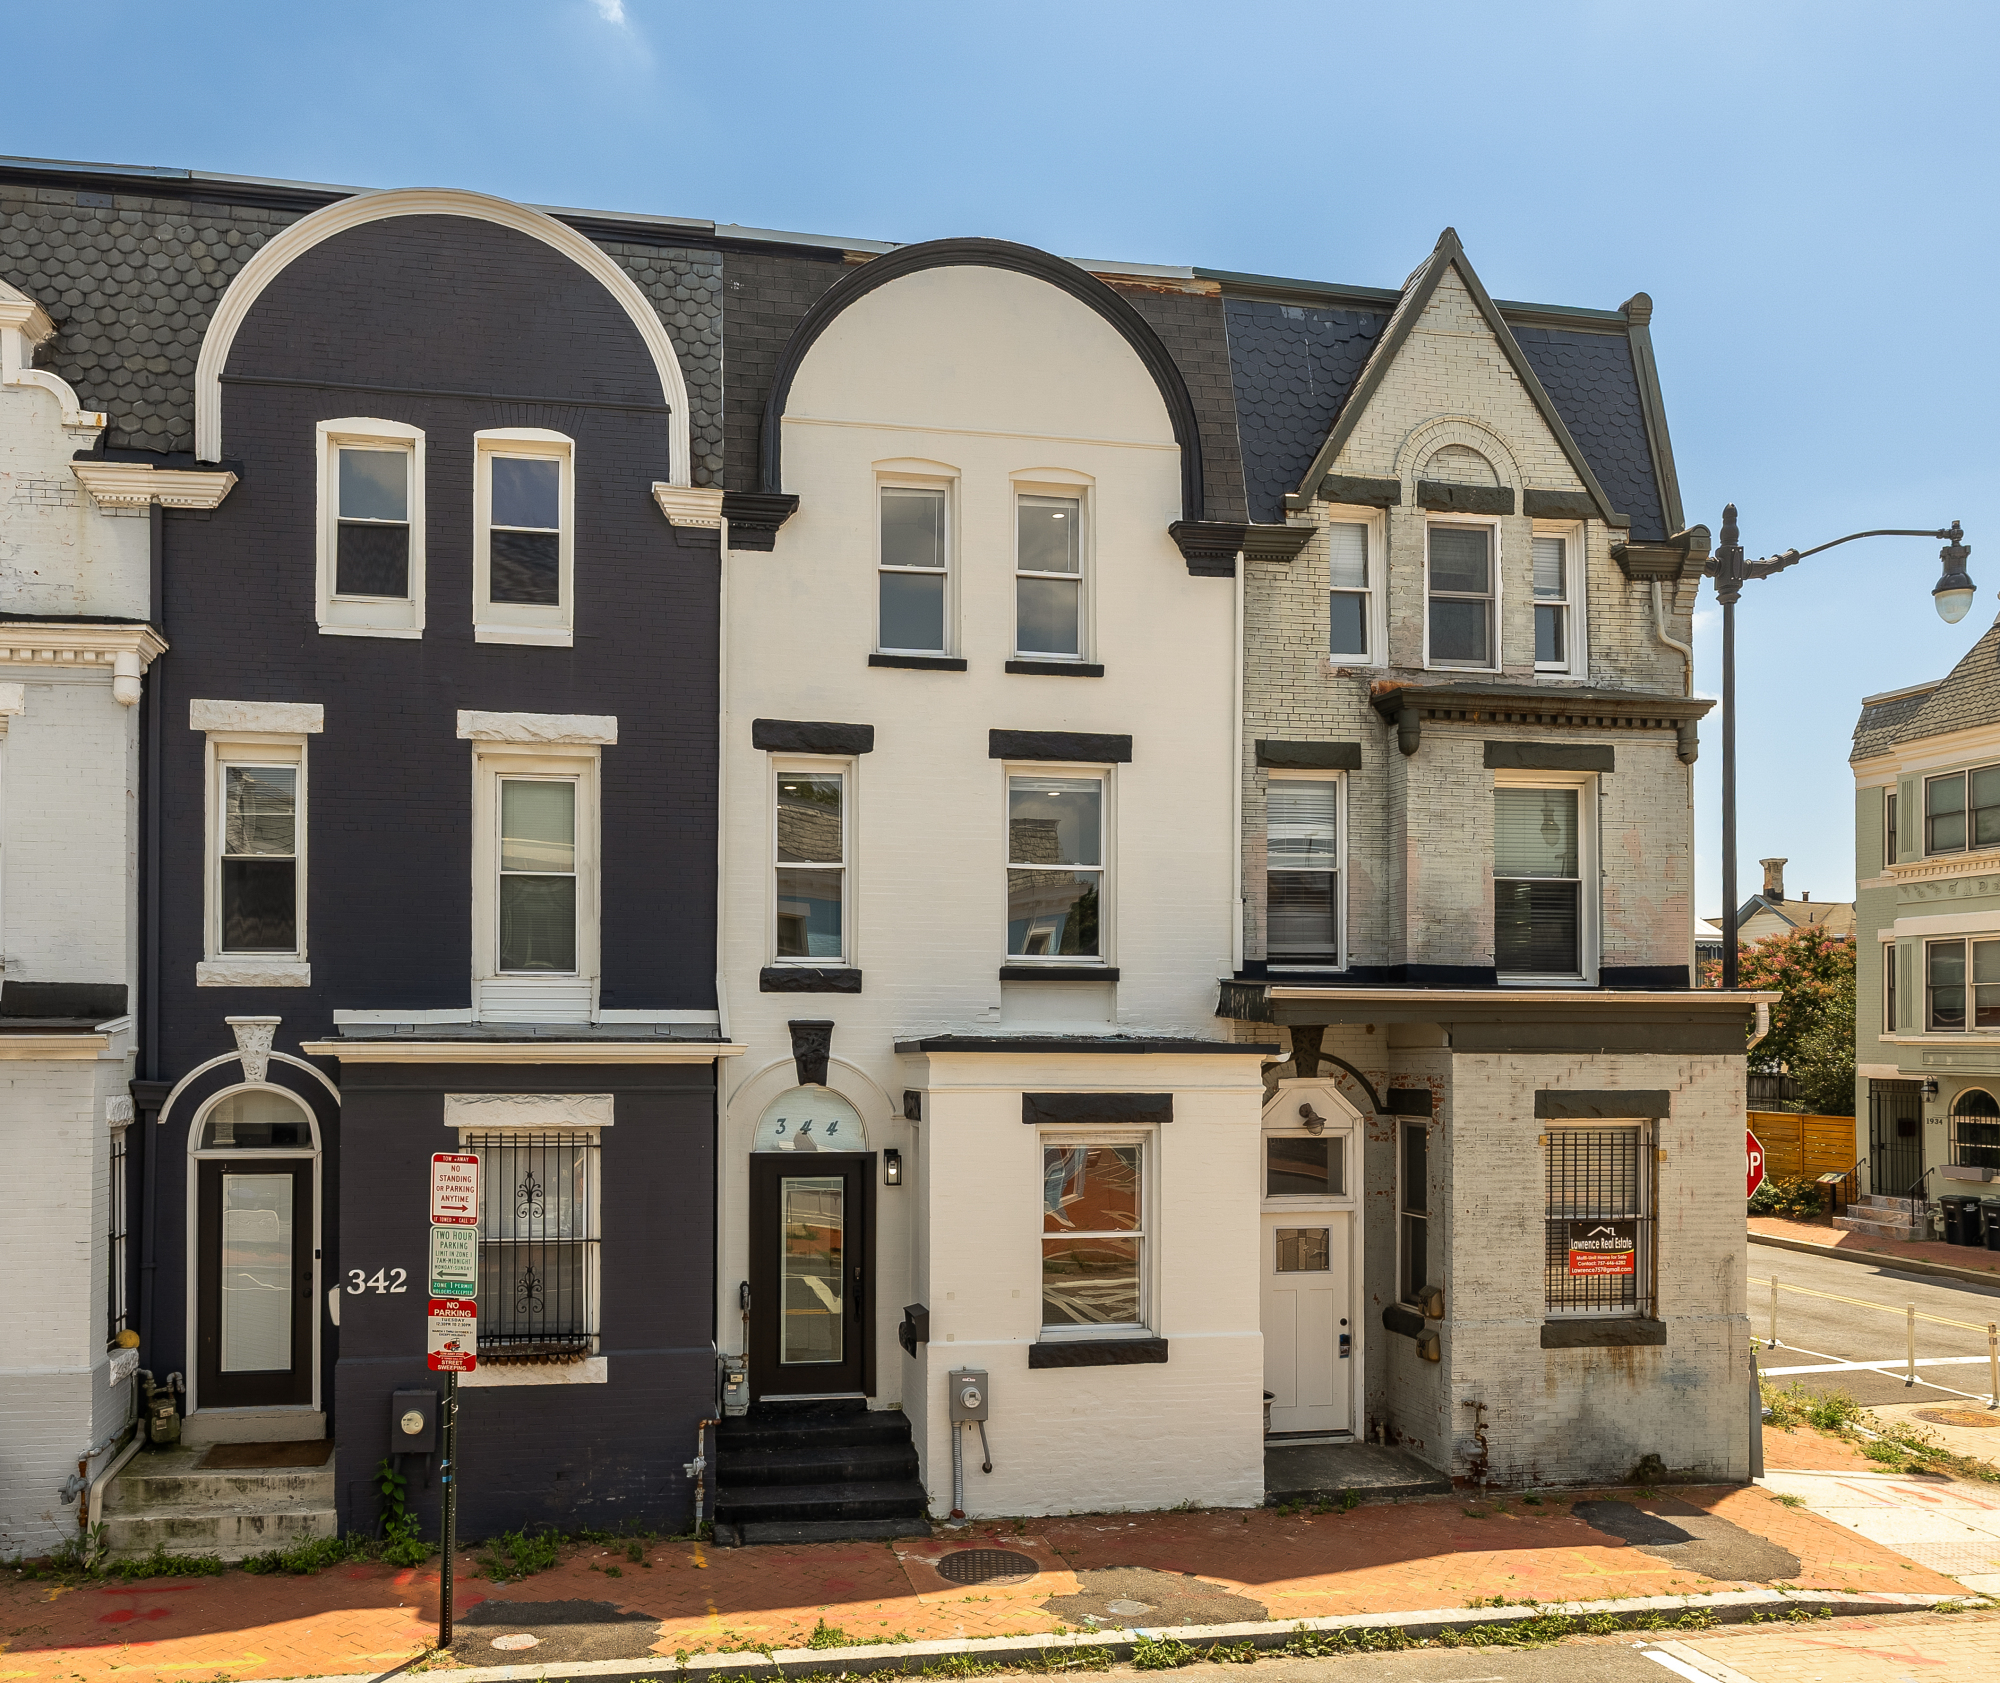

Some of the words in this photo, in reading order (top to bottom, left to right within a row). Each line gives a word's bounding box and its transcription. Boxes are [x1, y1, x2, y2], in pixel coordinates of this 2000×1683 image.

[775, 1118, 838, 1136] 344
[439, 1175, 472, 1183] STANDING
[446, 1185, 474, 1193] PARKING
[436, 1231, 449, 1240] TWO
[453, 1231, 472, 1240] HOUR
[1571, 1238, 1600, 1249] Lawrence
[1601, 1237, 1614, 1248] Real
[1615, 1237, 1632, 1248] Estate
[347, 1267, 407, 1294] 342
